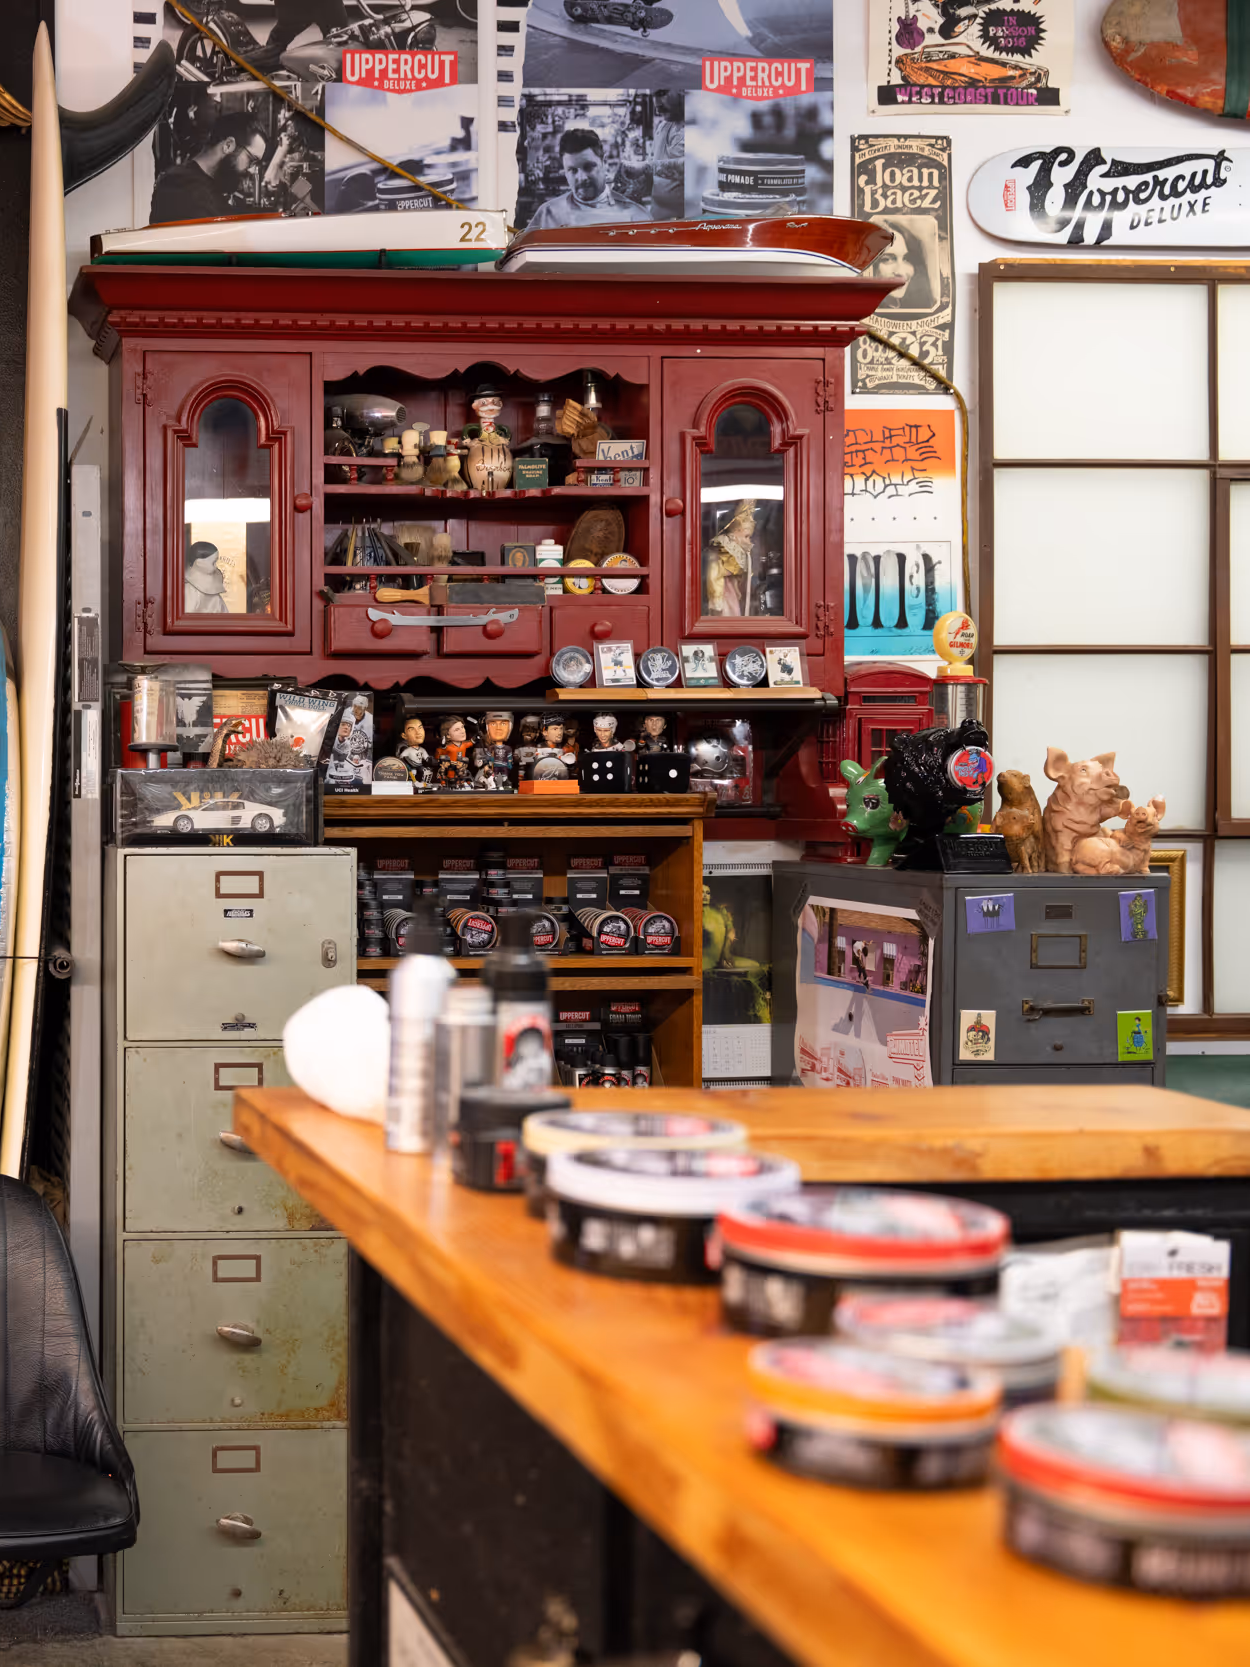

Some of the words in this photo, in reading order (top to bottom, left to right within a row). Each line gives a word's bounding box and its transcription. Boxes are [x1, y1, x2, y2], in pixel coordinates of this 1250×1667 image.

[988, 26, 1036, 37] PERSON
[345, 53, 455, 84] UPPERCUT
[705, 60, 811, 92] UPPERCUT
[383, 80, 416, 90] DELUXE
[742, 87, 774, 97] DELUXE
[895, 86, 942, 104] WEST
[943, 87, 995, 105] COAST
[997, 88, 1039, 106] TOUR
[857, 158, 941, 189] Joan
[862, 187, 942, 213] Baez
[1010, 146, 1234, 245] Uppercut
[1128, 196, 1212, 230] DELUXE
[458, 221, 488, 243] 22
[278, 693, 306, 704] WILD
[306, 697, 336, 708] WING
[600, 934, 626, 946] UPPERCUT
[646, 935, 671, 945] UPPERCUT
[559, 1011, 590, 1021] UPPERCUT
